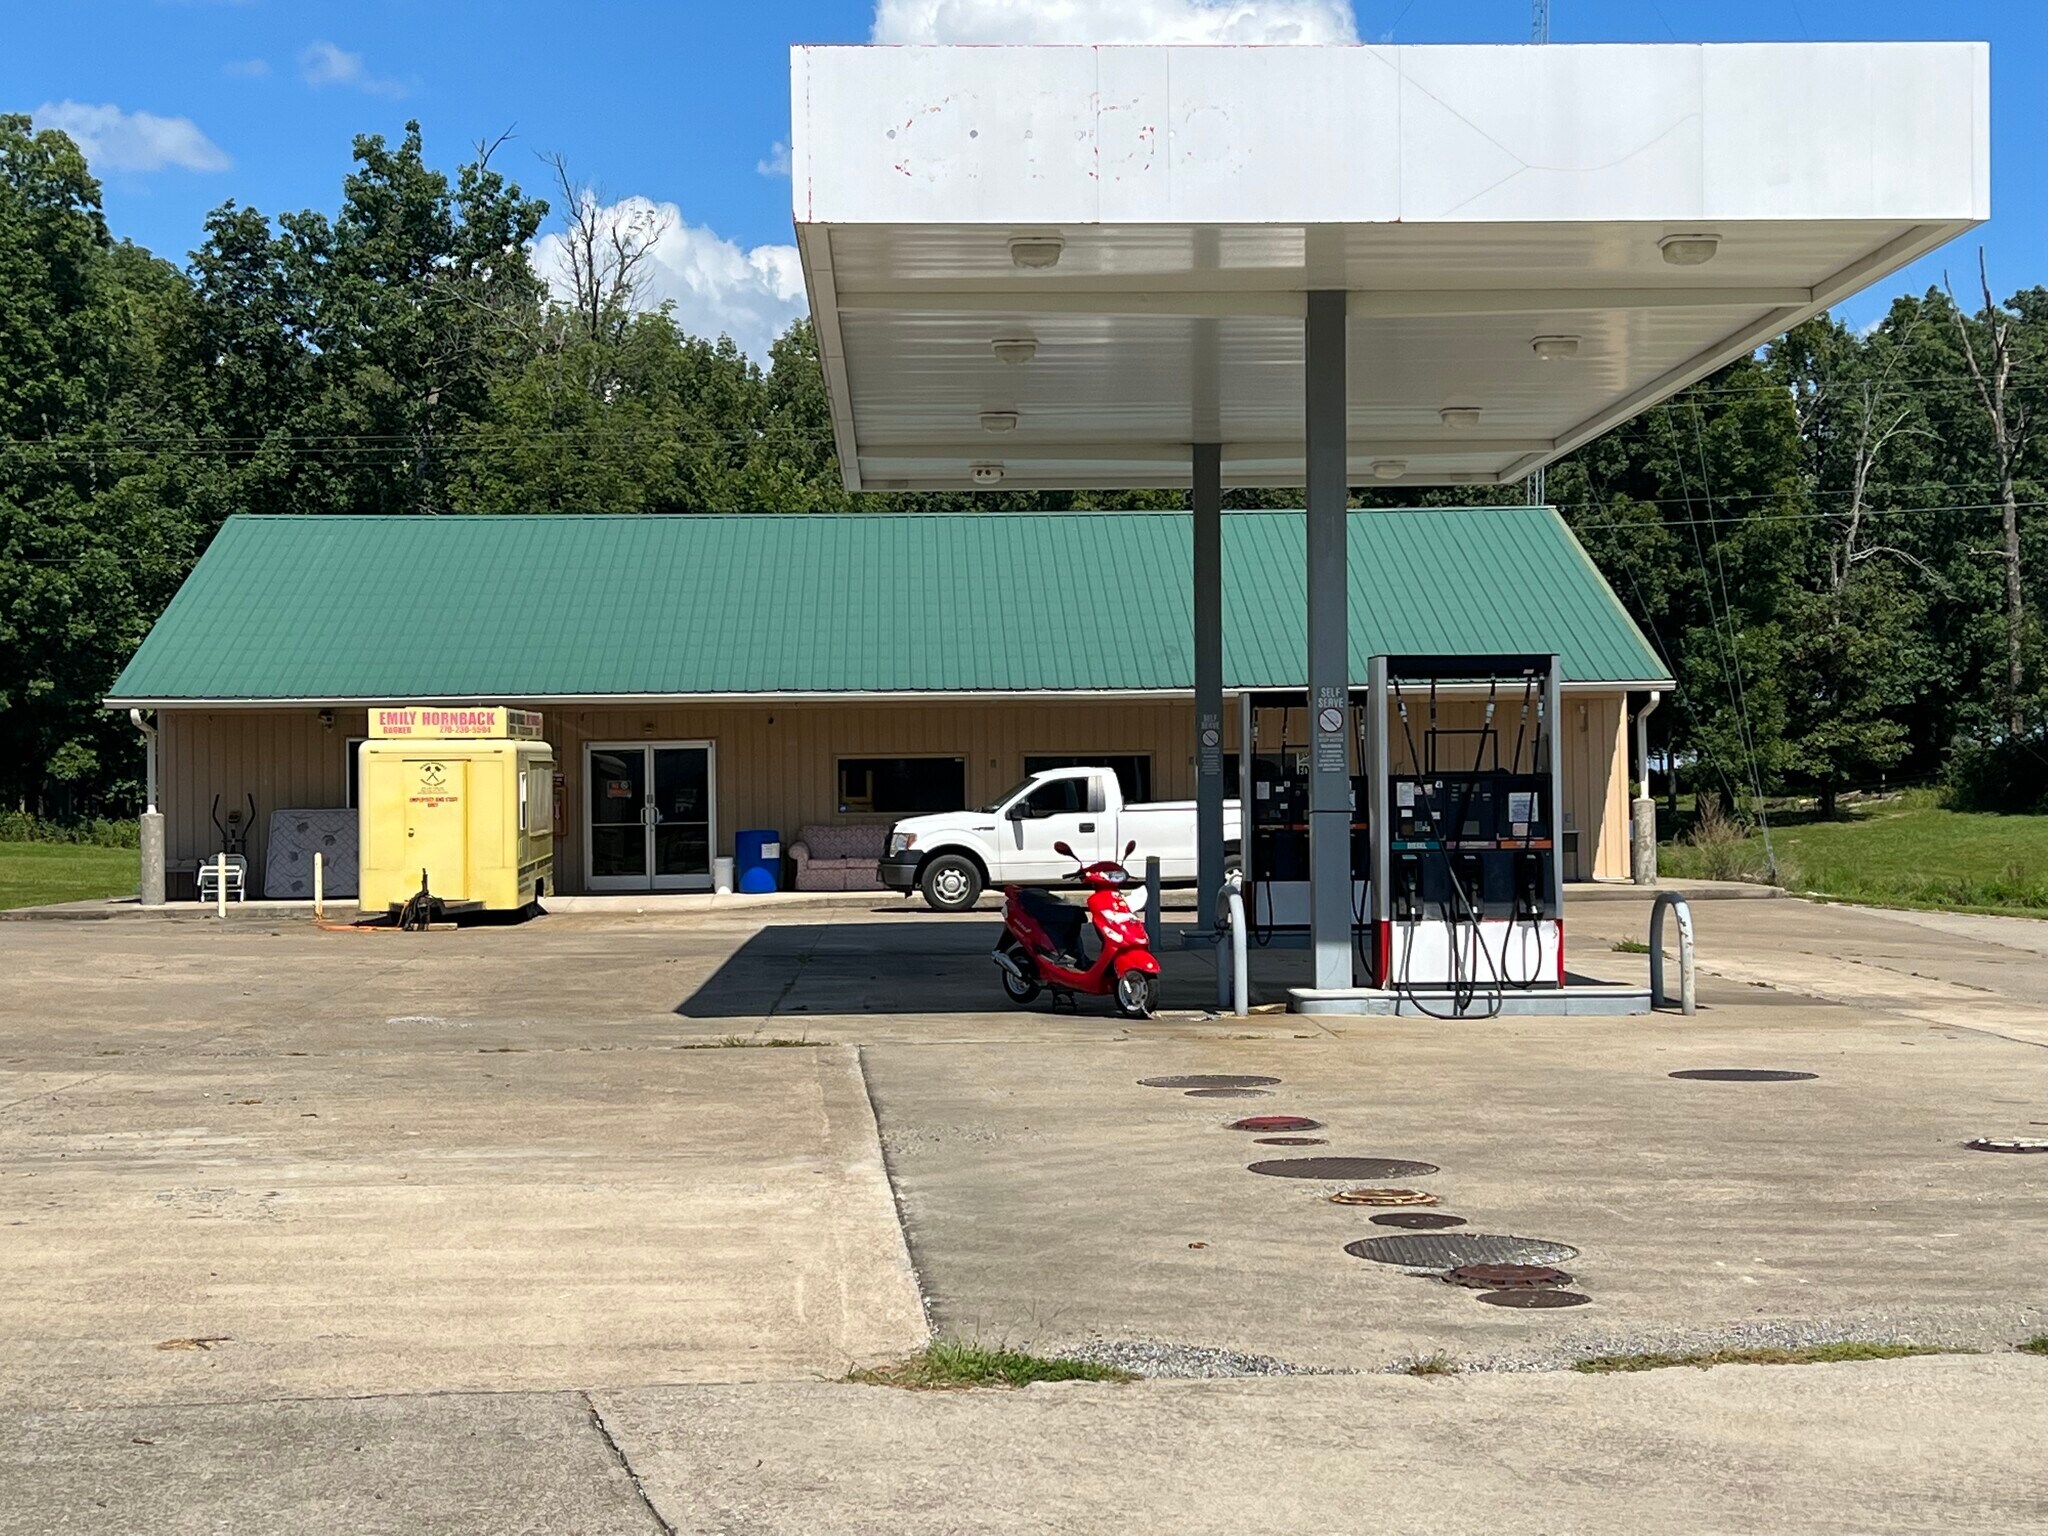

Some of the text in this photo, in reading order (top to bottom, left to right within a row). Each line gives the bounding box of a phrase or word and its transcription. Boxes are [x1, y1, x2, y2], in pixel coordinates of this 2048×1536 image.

[1321, 687, 1340, 697] SELF
[1318, 698, 1344, 708] SERVE
[380, 712, 416, 725] EMILY
[422, 712, 495, 725] HORNBACK
